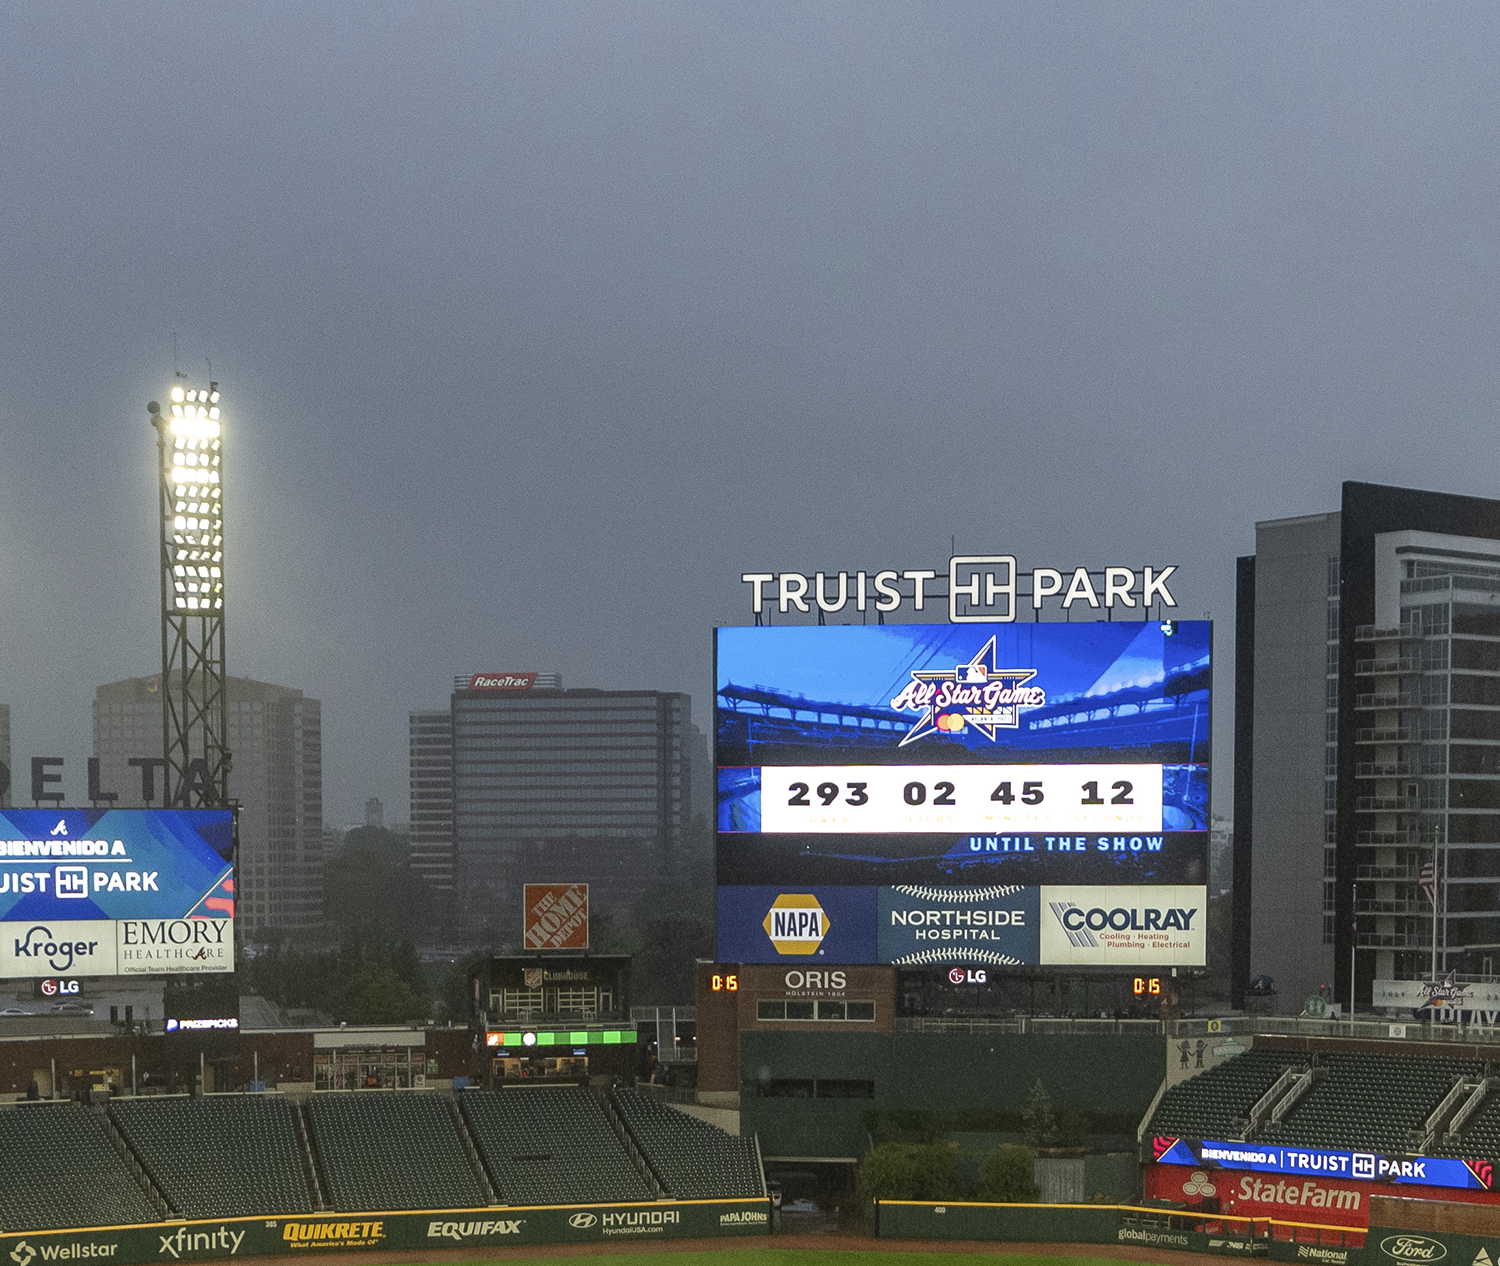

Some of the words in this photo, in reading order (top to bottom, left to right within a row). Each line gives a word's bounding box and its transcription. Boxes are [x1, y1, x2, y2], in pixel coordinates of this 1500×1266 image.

[741, 569, 936, 613] TRUIST
[1031, 565, 1180, 610] PARK
[474, 677, 529, 687] RaceTrac
[890, 681, 937, 711] All
[936, 681, 983, 707] Star
[982, 681, 1046, 710] Game
[787, 782, 869, 806] 293
[903, 782, 956, 806] 02
[990, 781, 1045, 806] 45
[1080, 780, 1135, 805] 12
[110, 839, 126, 856] A
[969, 836, 1035, 852] UNTIL
[1044, 836, 1088, 852] THE
[1097, 836, 1164, 852] SHOW
[93, 870, 160, 892] PARK
[532, 891, 558, 917] THE
[525, 884, 587, 949] HOME
[773, 912, 820, 938] NAPA
[891, 909, 1026, 928] NORTHSIDE
[1062, 906, 1198, 933] COOLRAY
[123, 919, 228, 946] EMORY
[550, 908, 587, 949] DEPOT
[915, 928, 1001, 942] HOSPITAL
[1099, 932, 1135, 942] Cooling
[1137, 932, 1170, 942] Heating
[14, 926, 98, 971] Kroger
[123, 946, 224, 961] HEALTHCARE
[1107, 940, 1149, 950] Plumbing
[1152, 940, 1191, 949] Electrical
[123, 965, 148, 973] Official
[149, 965, 164, 973] Team
[166, 965, 200, 973] Healthcare
[201, 965, 228, 973] Provider
[543, 971, 589, 981] CLUBHOUSE
[966, 970, 987, 983] LG
[59, 980, 79, 994] LG
[711, 974, 738, 993] 0:15
[784, 969, 847, 990] ORIS
[1133, 977, 1161, 995] 0:15
[179, 1018, 239, 1030] PRIZEPICKS
[1201, 1147, 1267, 1165] BIENVENIDO
[1267, 1153, 1278, 1165] A
[1286, 1151, 1350, 1173] TRUIST
[1378, 1158, 1427, 1179] PARK
[602, 1210, 681, 1227] HYUNDAI
[720, 1212, 740, 1223] PAPA
[740, 1211, 768, 1222] JOHNS
[934, 1206, 946, 1214] 400
[282, 1222, 384, 1243] QUIKRETE
[427, 1219, 522, 1241] EQUIFAX
[602, 1226, 664, 1235] HyundaiUSA.com
[1118, 1226, 1188, 1246] globalpayments
[158, 1225, 246, 1259] xfinity
[1391, 1237, 1435, 1260] Ford
[40, 1242, 118, 1262] Wellstar
[1308, 1247, 1348, 1260] National
